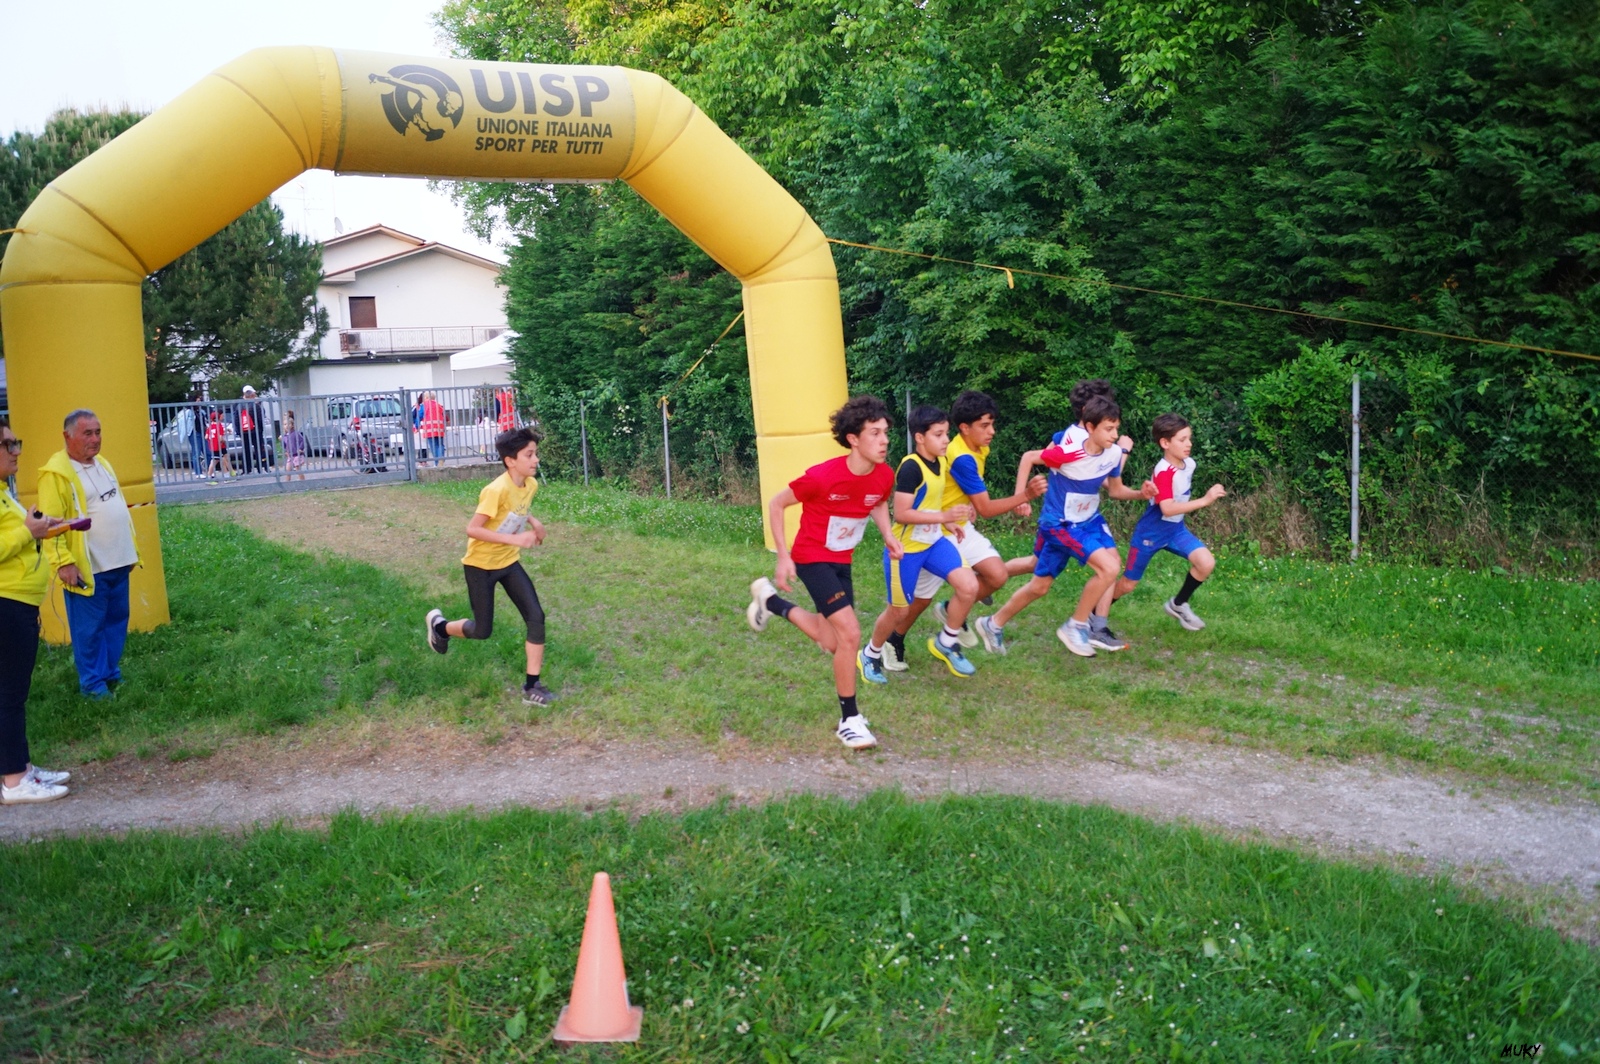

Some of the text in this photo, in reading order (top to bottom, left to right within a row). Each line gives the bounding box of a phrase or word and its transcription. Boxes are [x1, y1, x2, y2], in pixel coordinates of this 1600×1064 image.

[469, 69, 610, 117] UISP
[476, 117, 613, 138] UNIONE ITALIANA
[475, 137, 603, 155] SPORT PER TUTTI
[837, 527, 856, 540] 24
